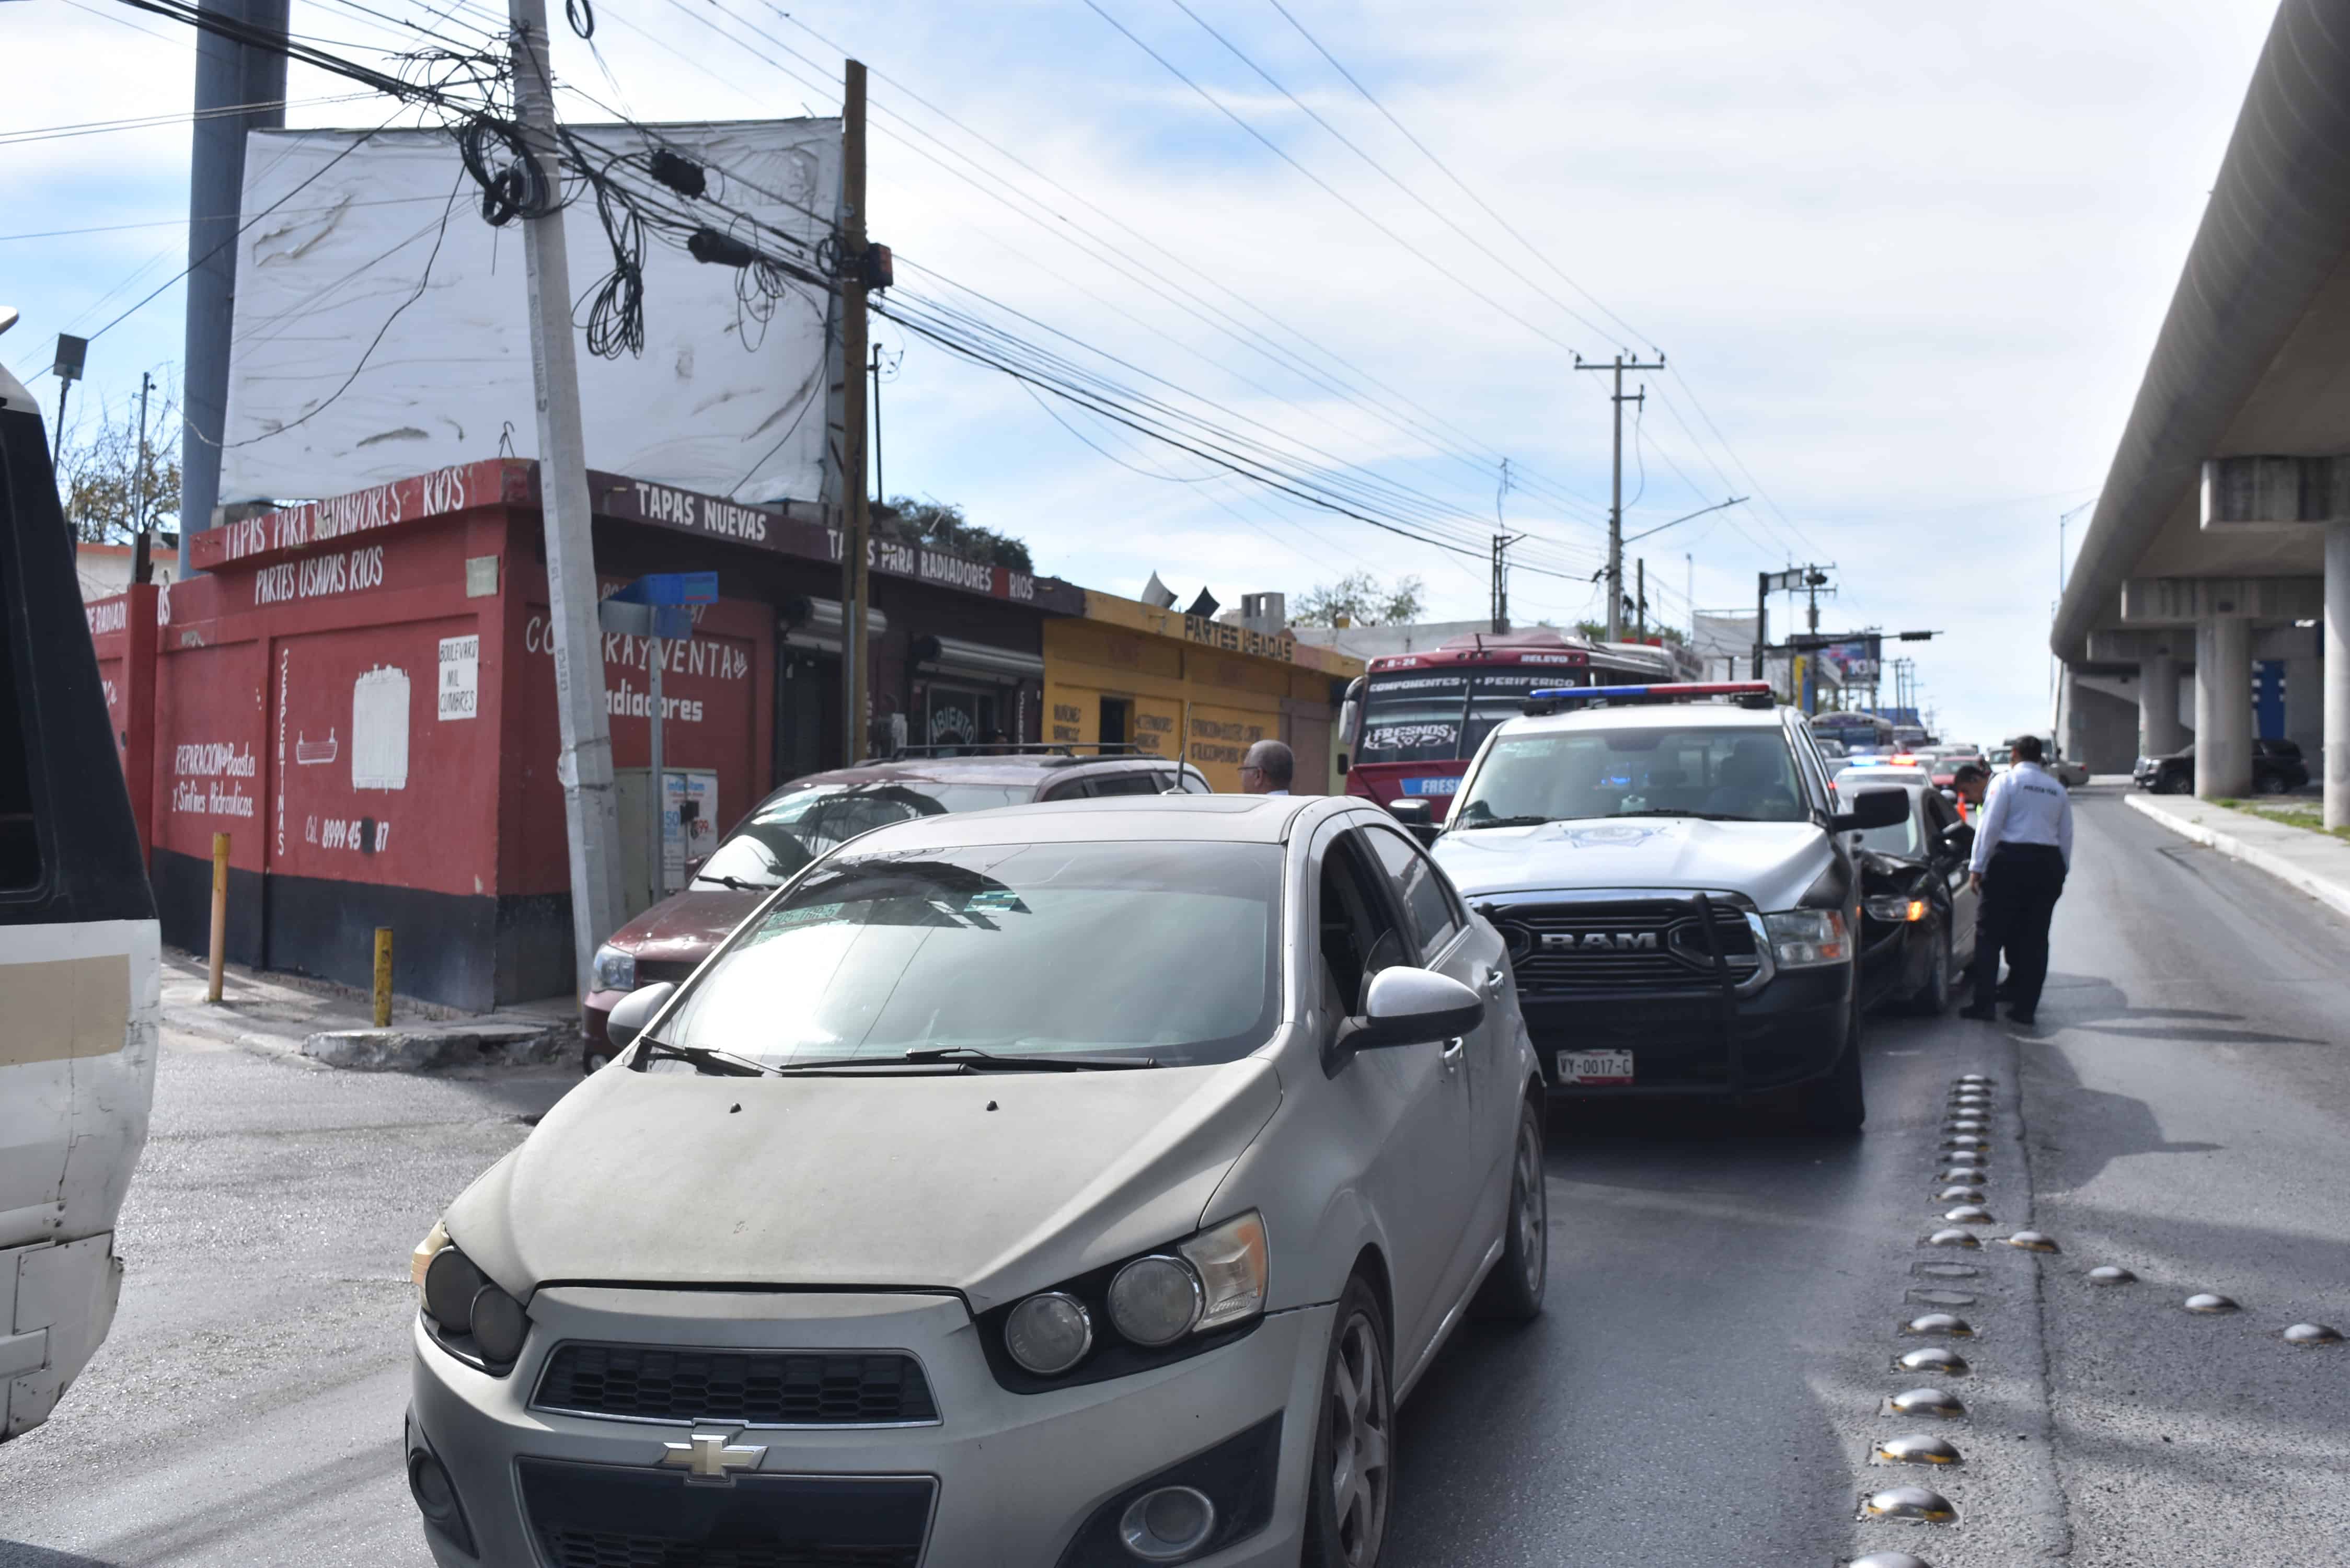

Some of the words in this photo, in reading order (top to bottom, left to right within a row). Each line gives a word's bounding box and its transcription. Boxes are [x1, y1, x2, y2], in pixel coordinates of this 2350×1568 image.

[225, 520, 266, 561] TAPAS
[273, 505, 308, 549] PARA
[314, 482, 401, 541] RADIADORES
[636, 481, 695, 525] TAPAS
[704, 499, 767, 541] NUEVAS
[255, 563, 295, 605] PARTES
[299, 552, 345, 598] USADAS
[350, 545, 384, 590] RIOS
[881, 541, 914, 574] PARA
[921, 550, 992, 592] RADIADORES
[1009, 572, 1034, 601] RIOS
[439, 640, 478, 662] BOULEVARD
[1185, 615, 1238, 651] PARTES
[1241, 627, 1292, 661] USADAS
[1521, 654, 1569, 663] RELEVO
[446, 669, 460, 687] MIL
[1369, 677, 1460, 692] COMPONENTES
[1484, 676, 1575, 687] PERIFERICO
[440, 690, 475, 713] CUMBRES
[606, 679, 703, 722] adiadores
[930, 707, 975, 745] ABIERTO
[1374, 724, 1450, 738] FRESNOS
[278, 648, 289, 856] SERPENTINAS
[322, 819, 346, 849] 8999
[348, 820, 361, 850] 45
[376, 822, 389, 852] 87
[1541, 933, 1657, 949] RAM
[1560, 1059, 1630, 1074] VY-0017-C
